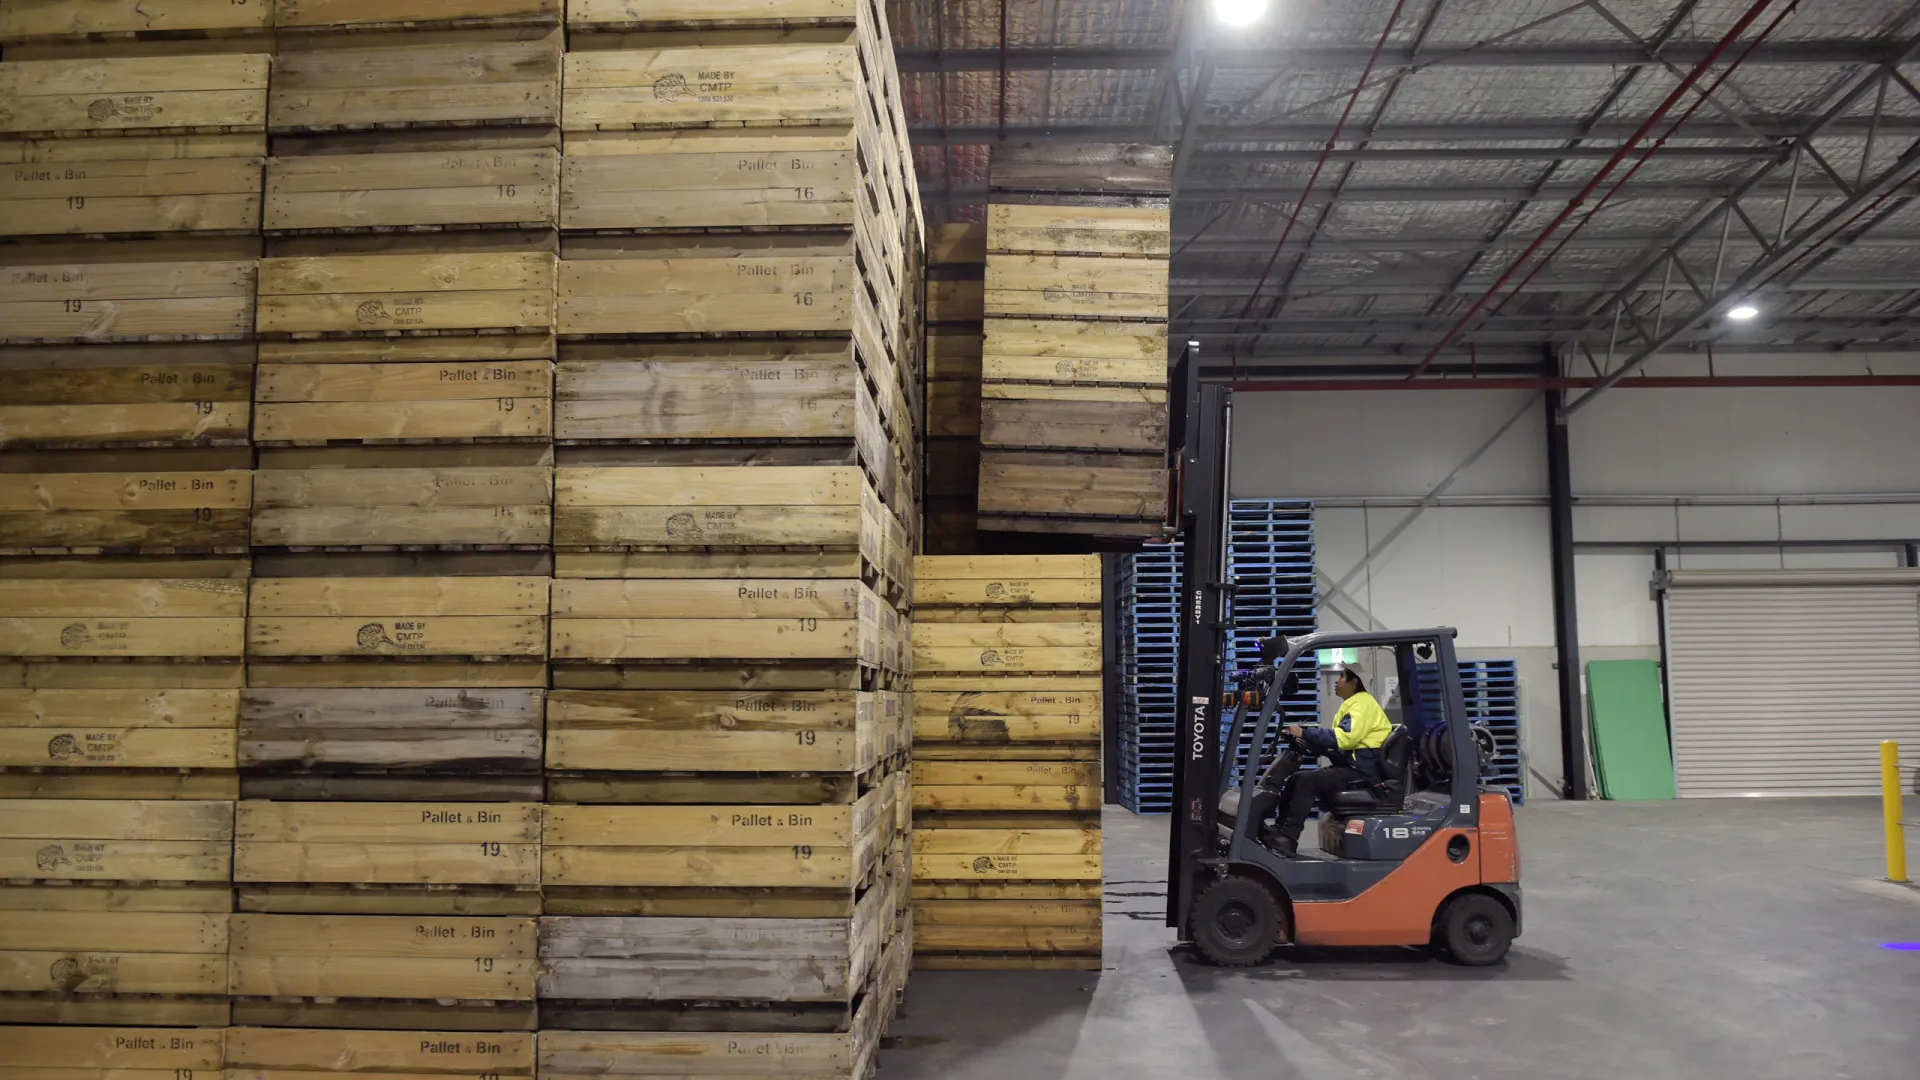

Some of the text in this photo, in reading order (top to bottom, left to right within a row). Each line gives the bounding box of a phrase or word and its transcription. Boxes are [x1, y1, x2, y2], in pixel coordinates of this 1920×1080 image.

[698, 71, 735, 80] MADE BY
[700, 82, 732, 92] CMTP
[738, 158, 815, 171] Pallet Bin
[14, 170, 51, 182] Pallet
[64, 168, 87, 181] Bin
[496, 183, 516, 198] 16
[794, 186, 814, 200] 16
[66, 196, 85, 210] 19
[737, 264, 815, 276] Pallet Bin
[793, 291, 813, 306] 16
[64, 298, 82, 313] 19
[395, 307, 423, 316] CMTP
[141, 373, 178, 385] Pallet
[192, 373, 215, 384] Bin
[439, 369, 478, 381] Pallet
[493, 368, 516, 380] Bin
[740, 368, 781, 380] Pallet
[195, 401, 213, 414] 19
[496, 396, 515, 412] 19
[138, 479, 177, 491] Pallet
[191, 479, 214, 491] Bin
[193, 507, 212, 522] 19
[705, 511, 738, 519] MADE BY
[738, 587, 778, 600] Pallet
[794, 587, 818, 600] Bin
[394, 622, 426, 631] MADE BY
[798, 617, 818, 632] 19
[396, 632, 424, 641] CMTP
[425, 696, 462, 708] Pall
[735, 700, 776, 712] Pallet
[792, 700, 816, 712] Bin
[1031, 696, 1080, 704] Pallet Bin
[1068, 712, 1080, 725] 19
[86, 733, 117, 741] MADE BY
[796, 730, 817, 745] 19
[1193, 705, 1205, 760] TOYOTA
[87, 743, 115, 752] CMTP
[1027, 766, 1077, 775] Pallet Bin
[1065, 784, 1076, 795] 19
[421, 810, 463, 824] Pallet
[477, 811, 502, 824] Bin
[731, 814, 773, 827] Pallet
[788, 814, 813, 827] Bin
[1383, 827, 1409, 839] 18
[480, 841, 501, 857] 19
[791, 845, 813, 860] 19
[415, 925, 496, 938] Pallet Bin
[474, 957, 494, 972] 19
[116, 1036, 156, 1049] Pallet
[170, 1037, 194, 1049] Bin
[420, 1040, 461, 1053] Pallet
[476, 1041, 501, 1054] Bin
[175, 1068, 193, 1080] 19
